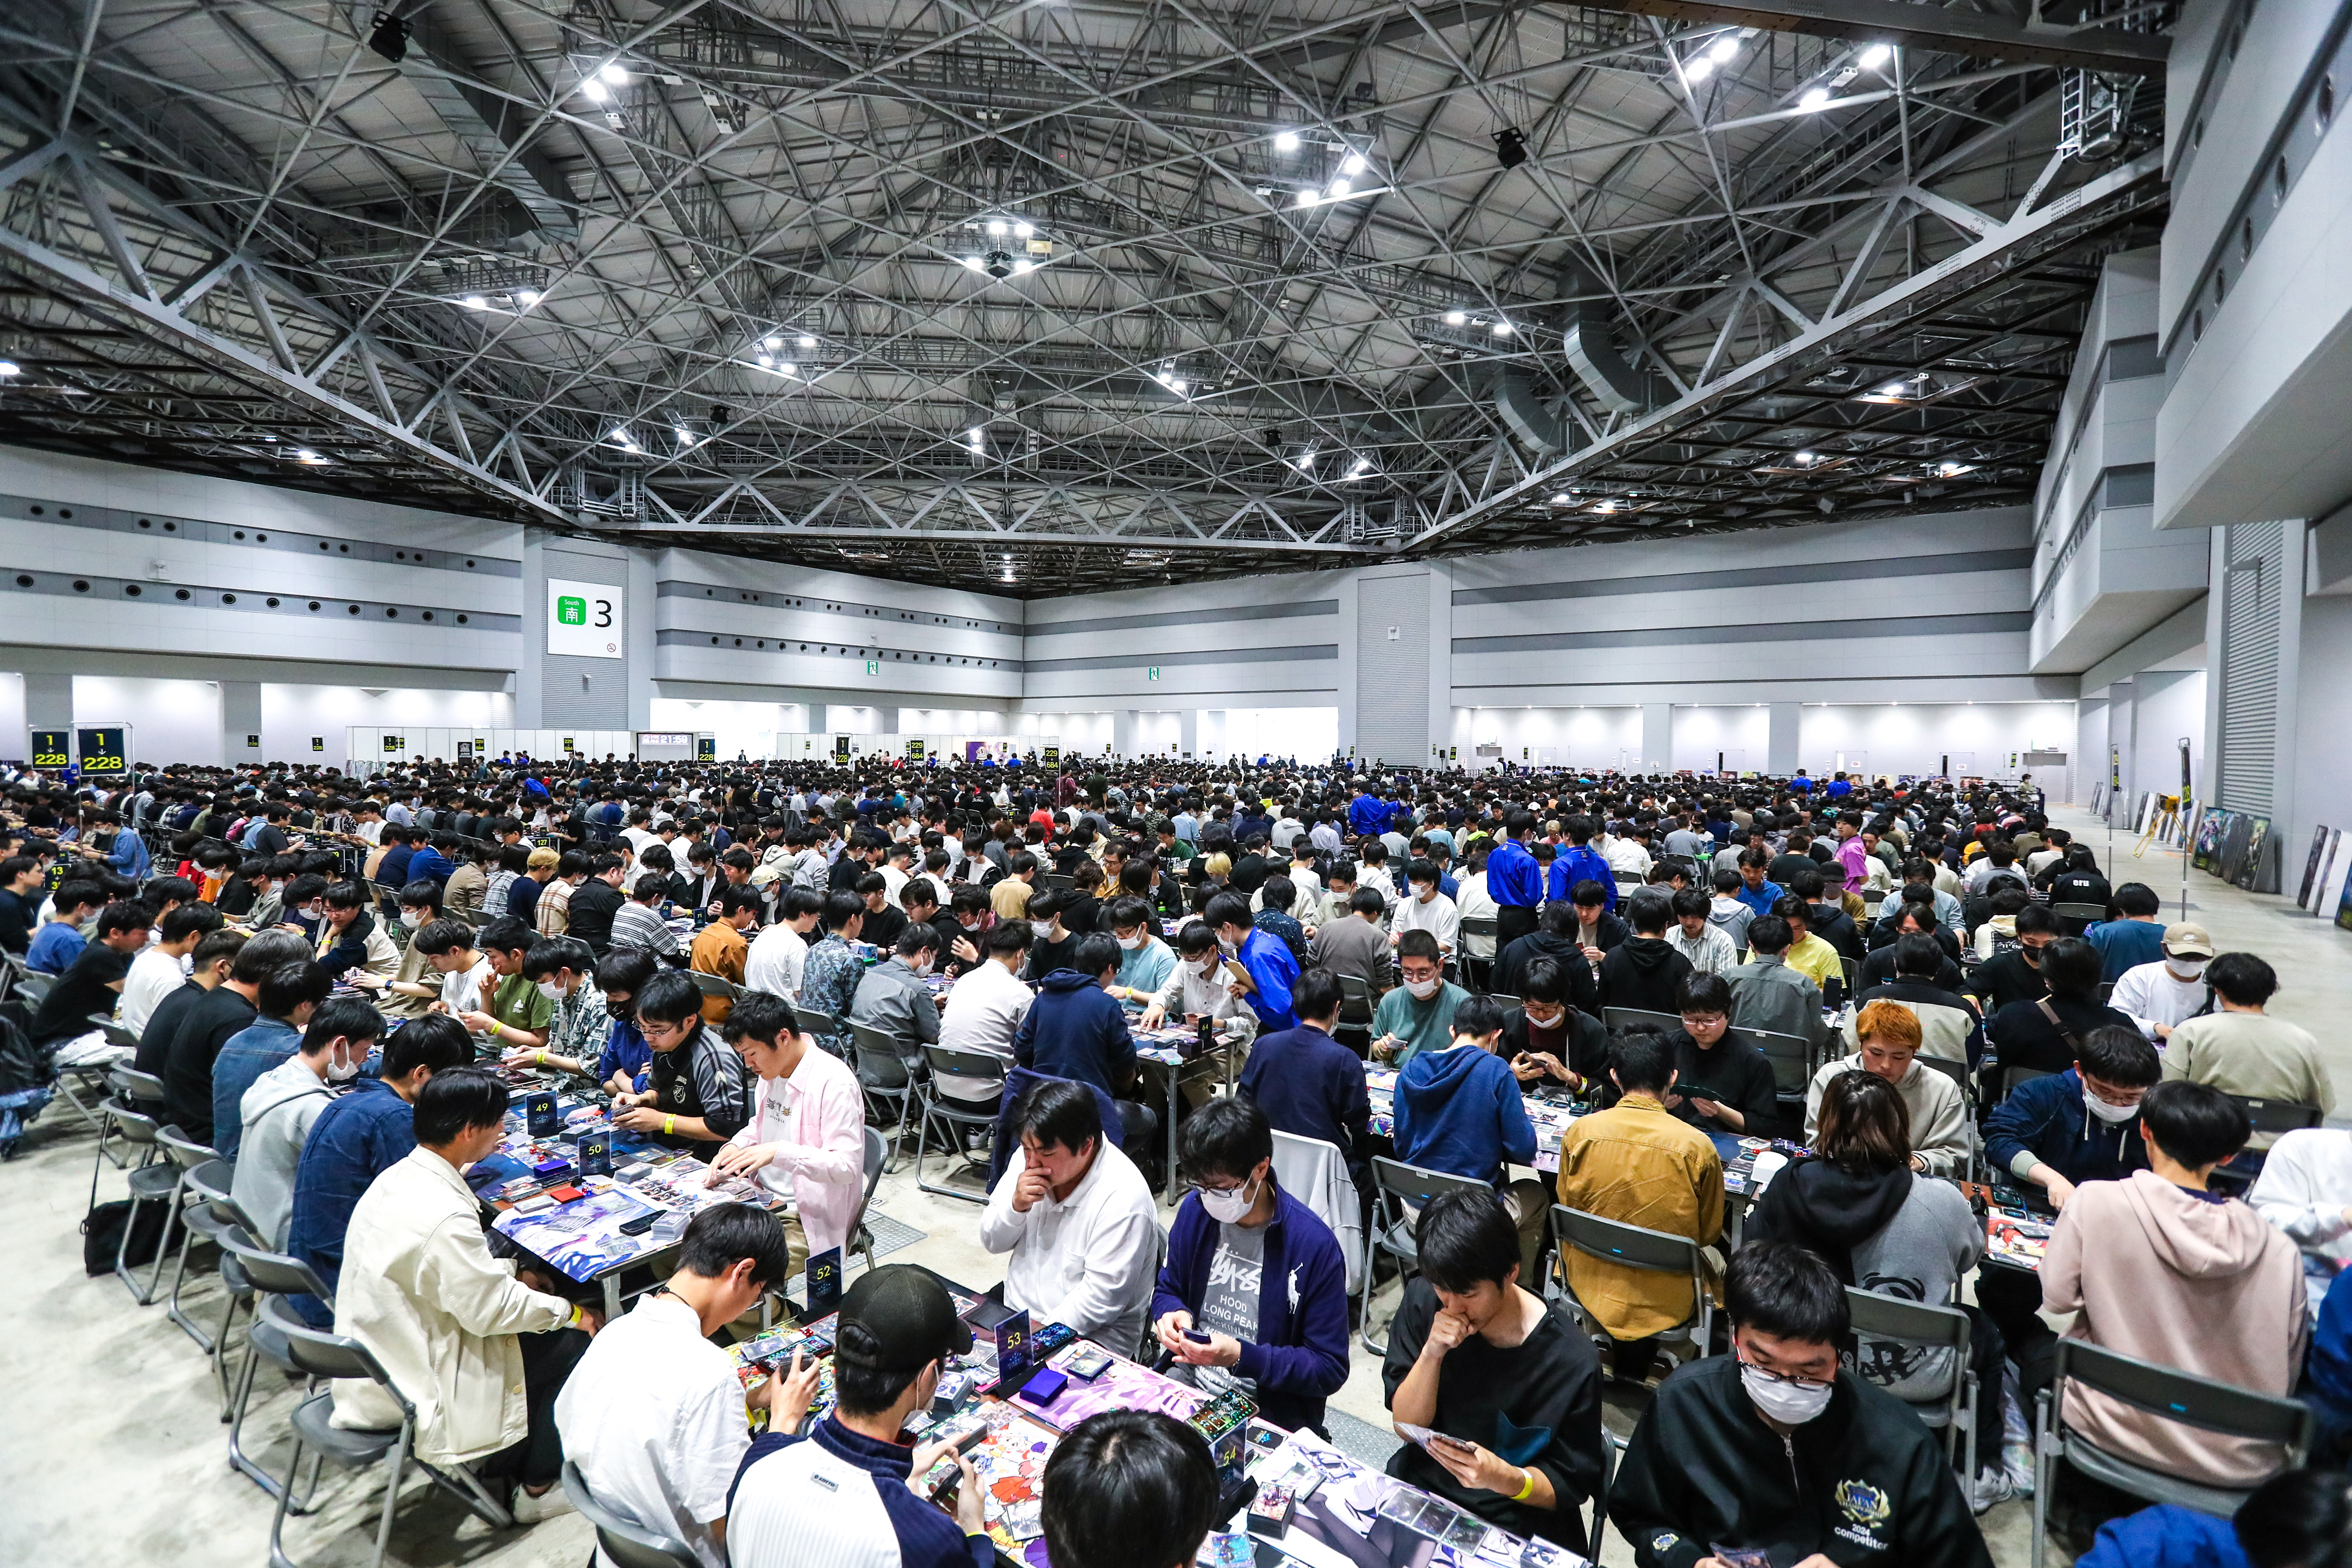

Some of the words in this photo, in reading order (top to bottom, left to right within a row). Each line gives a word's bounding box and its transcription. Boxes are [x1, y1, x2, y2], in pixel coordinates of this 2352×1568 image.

[566, 606, 578, 622] 南
[594, 600, 612, 628] 3
[46, 735, 53, 745] 1
[96, 733, 104, 746] 1
[660, 735, 688, 744] 21:59
[841, 740, 845, 748] 1
[35, 754, 67, 765] 228
[84, 756, 123, 770] 228
[51, 867, 63, 875] 13
[536, 1103, 548, 1112] 49
[588, 1144, 601, 1155] 50
[817, 1265, 830, 1280] 52
[1220, 1294, 1247, 1313] HOOD
[1204, 1302, 1231, 1320] LONG
[1008, 1332, 1021, 1349] 53
[1224, 1446, 1236, 1467] 54
[1847, 1494, 1877, 1509] JAPAN
[1852, 1523, 1871, 1536] 2024
[1834, 1526, 1889, 1550] competitor
